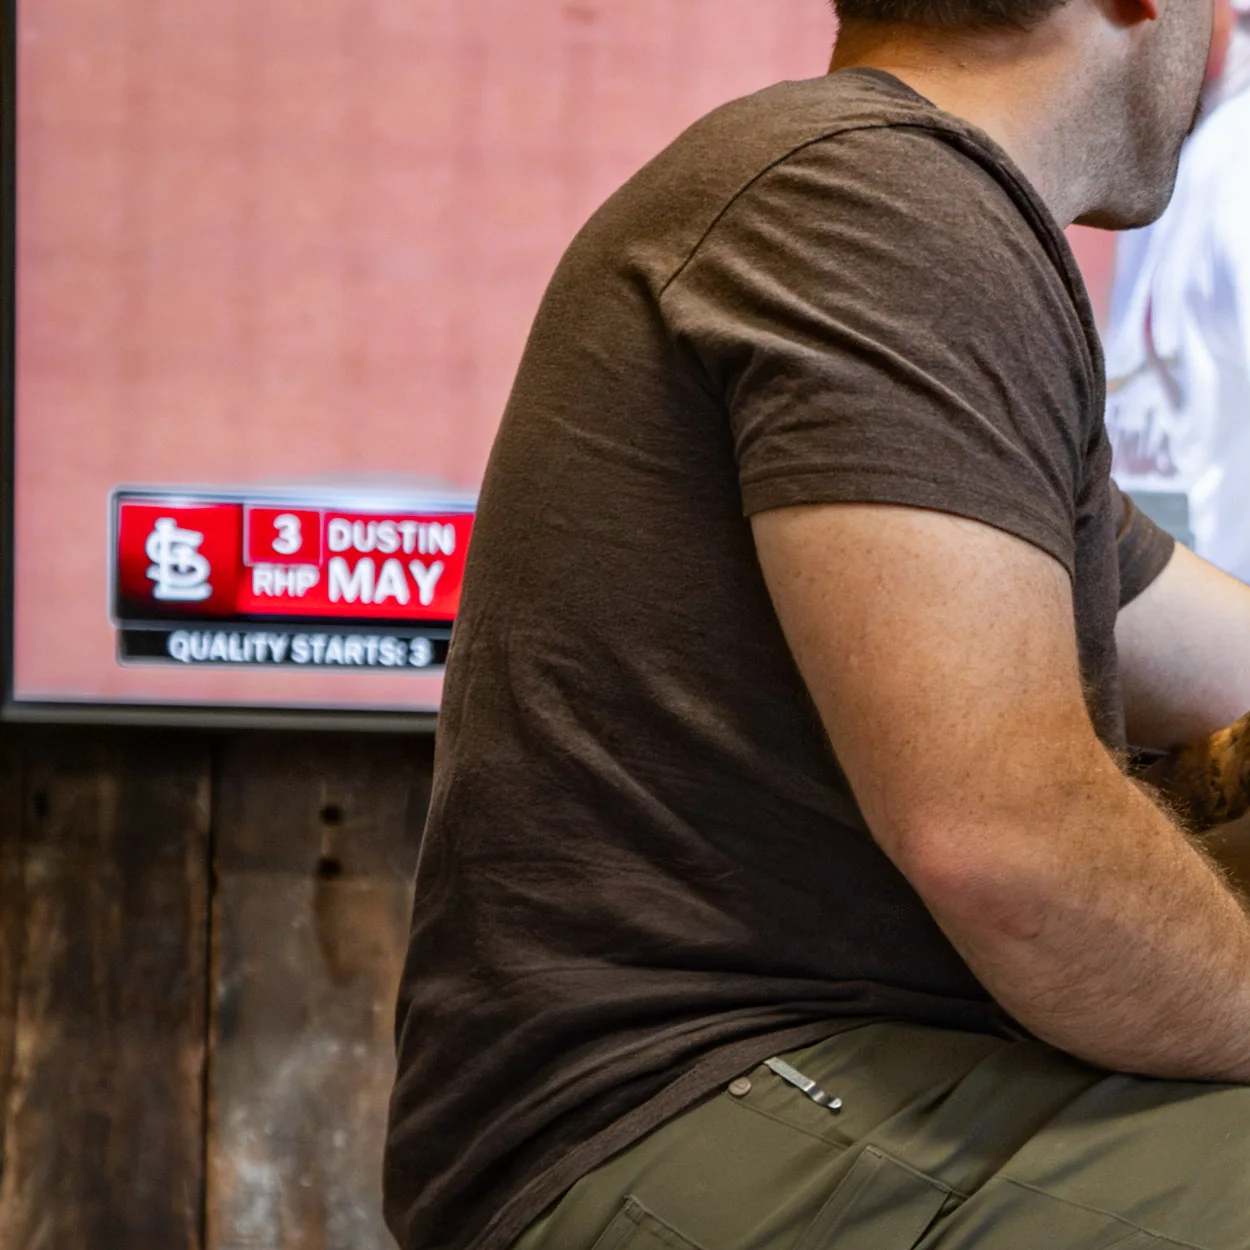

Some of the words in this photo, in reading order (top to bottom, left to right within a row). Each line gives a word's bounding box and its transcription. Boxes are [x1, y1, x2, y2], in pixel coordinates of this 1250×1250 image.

[272, 513, 303, 555] 3
[327, 518, 456, 556] DUSTIN
[251, 563, 321, 598] RHP
[327, 556, 446, 606] MAY
[167, 629, 290, 664] QUALITY
[291, 633, 408, 667] STARTS:
[408, 635, 434, 668] 3
